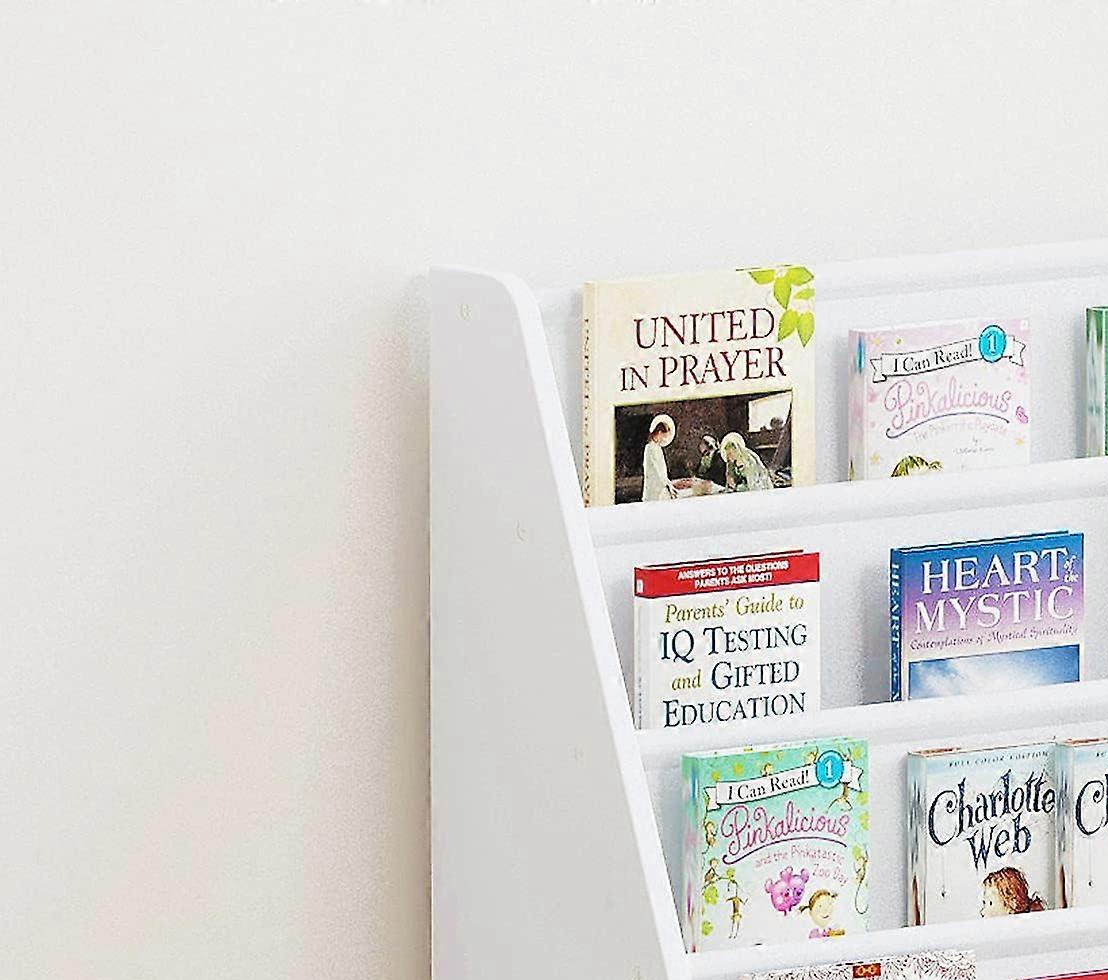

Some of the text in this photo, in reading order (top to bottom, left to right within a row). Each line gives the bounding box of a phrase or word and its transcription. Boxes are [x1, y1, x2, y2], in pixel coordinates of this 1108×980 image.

[634, 307, 775, 349] UNITED
[620, 347, 787, 391] IN PRAYER
[894, 332, 997, 372] I Can Read! 1
[884, 376, 1012, 430] Pinkalicious
[678, 560, 789, 580] ANSWERS TO THE QUESTIONS
[694, 578, 730, 589] PARENTS
[731, 575, 747, 584] ASK
[921, 547, 1069, 594] HEART
[736, 593, 783, 616] Guide
[789, 595, 804, 610] to
[915, 586, 1074, 634] MYSTIC
[660, 624, 807, 664] IQ TESTING
[910, 638, 973, 651] Contemplations
[988, 628, 1027, 644] Mystical
[672, 660, 800, 691] and GIFTED
[663, 692, 806, 728] EDUCATION
[728, 761, 834, 801] I Can Read! 1
[928, 769, 1056, 846] Charlotte
[721, 801, 850, 855] Pinkalicious
[966, 813, 1032, 870] Web
